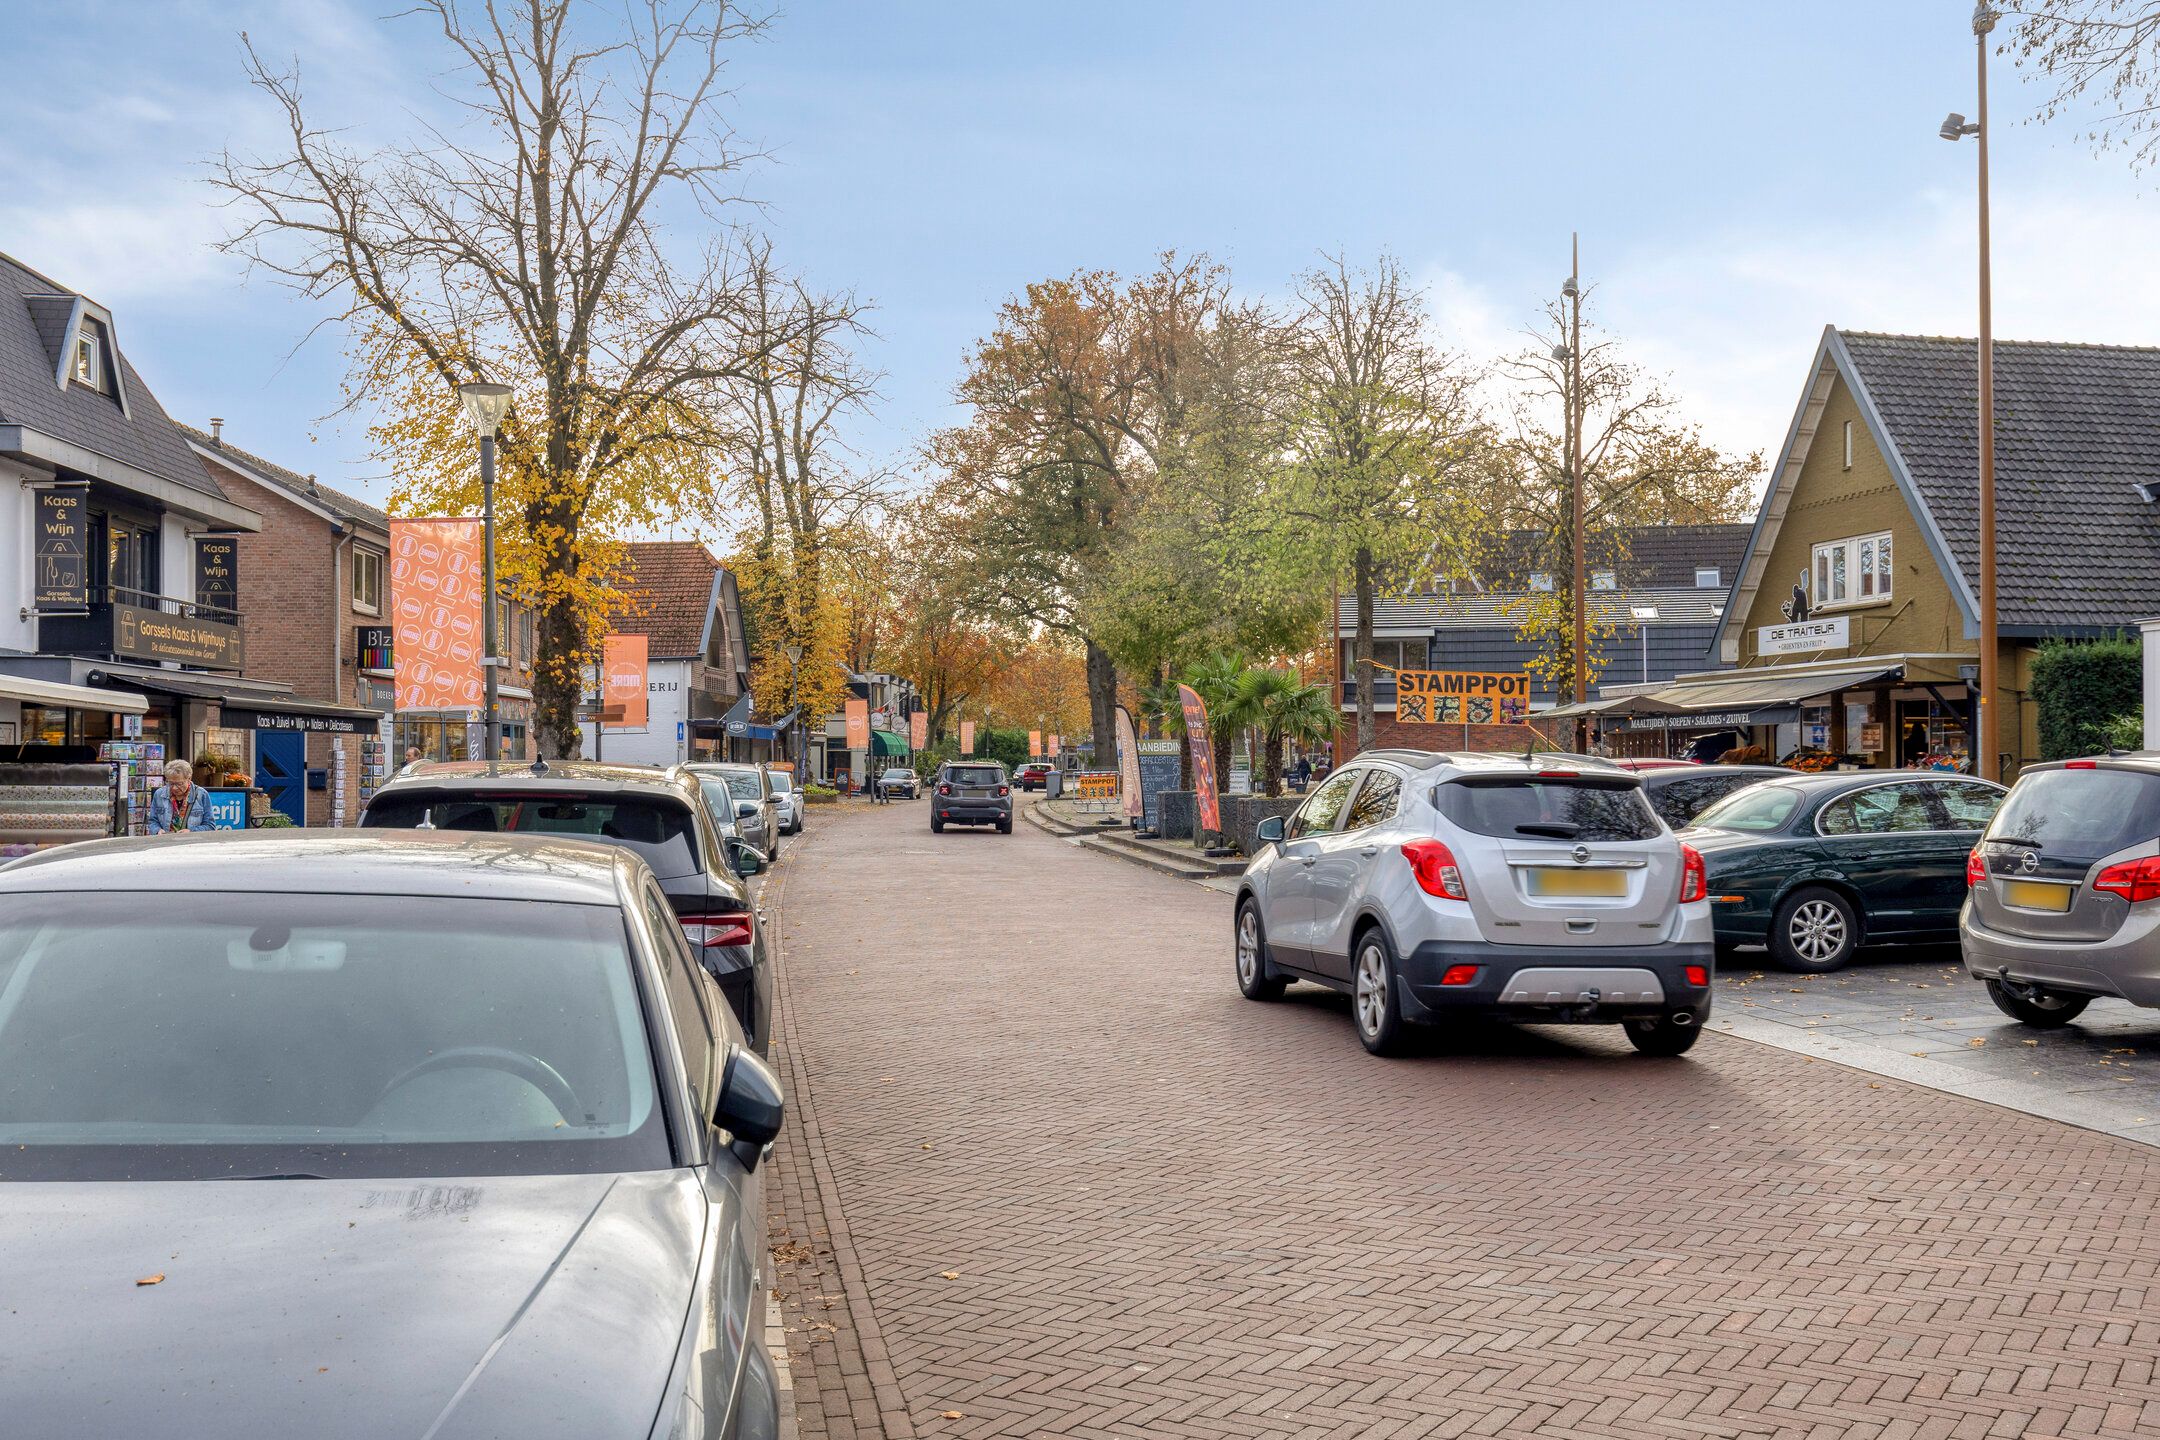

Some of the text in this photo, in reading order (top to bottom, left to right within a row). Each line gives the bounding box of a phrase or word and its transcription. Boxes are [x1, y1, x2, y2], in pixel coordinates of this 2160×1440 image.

[44, 495, 77, 507] Kaas
[56, 509, 66, 520] &
[46, 523, 74, 536] Wijn
[203, 544, 231, 553] Kaas
[213, 555, 222, 564] &
[204, 566, 228, 577] Wijn
[140, 620, 226, 652] Gorssels Kaas & Wijnhuys
[1771, 624, 1834, 639] DE TRAITEUR
[647, 682, 678, 692] ERIJ
[1399, 673, 1529, 695] STAMPPOT
[257, 715, 271, 727] Kaas
[276, 716, 290, 728] Zuivel
[295, 717, 305, 731] Wijn
[311, 718, 324, 730] Noten
[1631, 713, 1750, 730] MAALTIJDEN SOEPEN SALADES ZUIVEL
